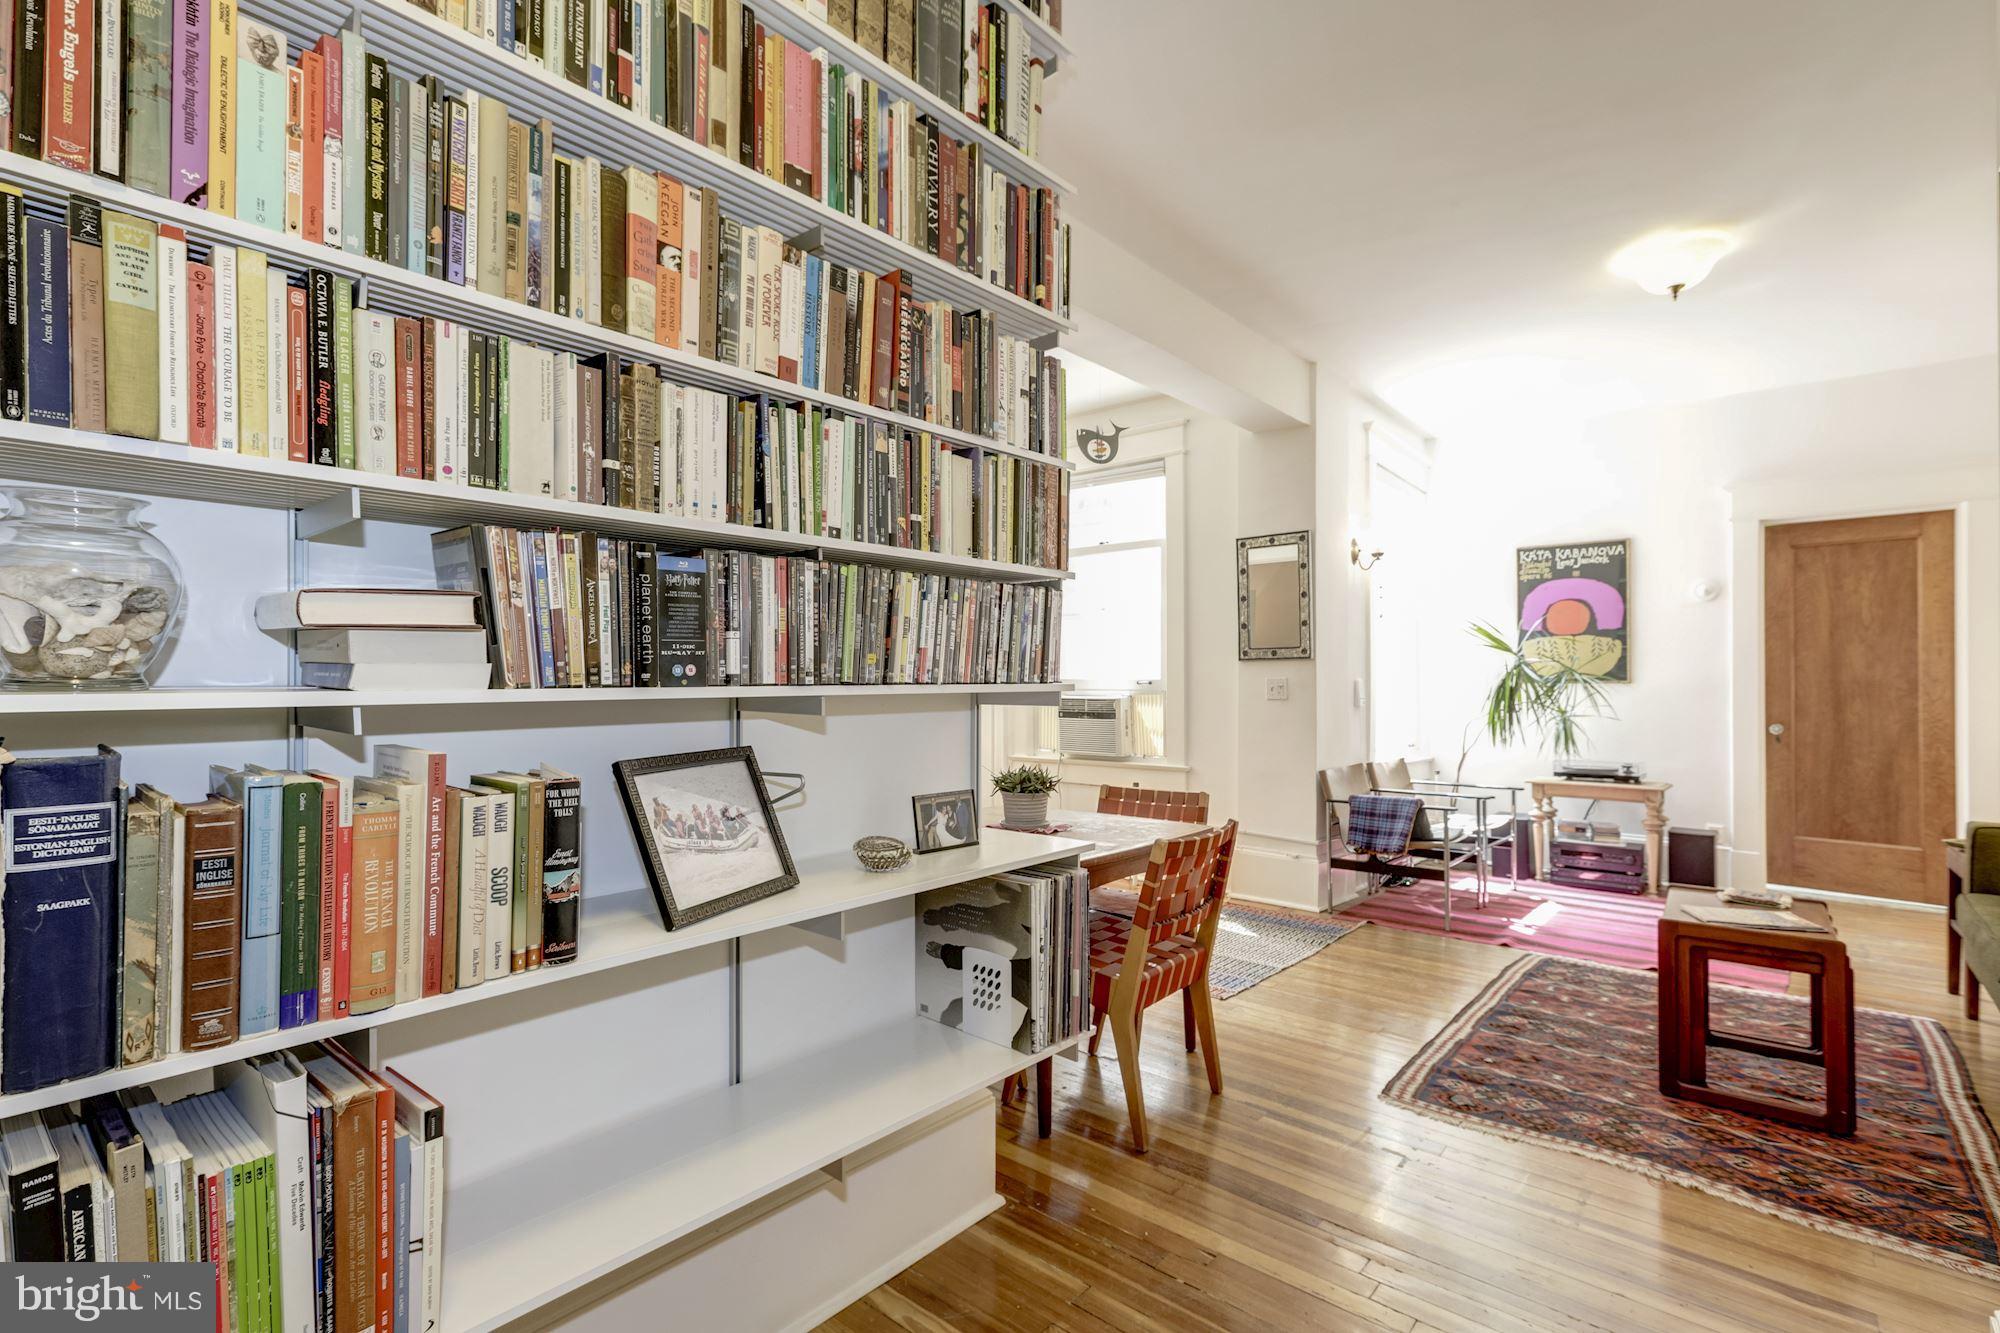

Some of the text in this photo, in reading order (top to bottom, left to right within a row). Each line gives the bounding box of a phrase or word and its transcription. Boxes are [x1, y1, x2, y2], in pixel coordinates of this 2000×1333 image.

[25, 11, 40, 51] Revolution
[574, 0, 585, 69] PUNISHMENT
[182, 0, 200, 146] khtin The Dialogic Imagination
[1020, 53, 1029, 121] SHATTERED
[62, 83, 75, 125] READER
[219, 55, 229, 154] DIALECTIC OF ENLIGHTENMENT
[367, 98, 385, 201] Ghost Stories and Mysteries
[468, 153, 477, 201] SIMULACRA
[927, 137, 939, 234] CHIVALRY
[371, 211, 384, 230] Dover
[659, 182, 670, 238] KEEGAN
[671, 200, 679, 227] JOHN
[114, 243, 150, 258] SAPPHIRA
[451, 212, 464, 265] FRANTZ FANON
[467, 210, 476, 265] SIMULATION
[6, 195, 18, 325] MADAME DE SÉVIGNÉ SELECTED LETTERS
[115, 251, 150, 265] AND THE
[119, 261, 146, 272] SLAVE
[40, 228, 53, 344] Actes du Tribunal révolutionnaire
[115, 281, 149, 294] CATHER
[122, 270, 144, 280] GIRL
[669, 277, 677, 292] THE
[89, 279, 99, 305] Typee
[659, 273, 668, 329] WORLD WAR
[761, 273, 772, 327] UP FOREVER
[315, 273, 330, 369] OCTAVIA E. BUTLER
[338, 282, 351, 375] UNDER THE GLACIER
[804, 292, 813, 337] HISTORY
[223, 256, 233, 423] PAUL TILLICH THE COURAGE TO BE
[898, 297, 909, 387] KIERKEGAARD
[377, 374, 387, 422] GAUDY NIGHT
[406, 366, 414, 408] DANIEL DEFOE
[423, 343, 434, 425] THE VOICES OF TIME
[316, 379, 331, 427] fledgling
[1554, 544, 1625, 561] KABANOVA
[586, 577, 596, 607] ANGELS
[664, 573, 701, 591] Harry Potter
[587, 613, 598, 645] AMERICA
[639, 573, 655, 665] planet earth
[299, 792, 307, 811] Collins
[545, 787, 580, 799] FOR WHOM
[547, 797, 579, 808] THE BELL
[27, 821, 101, 835] SÕNARAAMAT
[28, 813, 101, 827] EESTI-INGLISE
[361, 822, 398, 833] CARLYLE
[363, 815, 398, 826] THOMAS
[471, 805, 487, 837] WAUGH
[493, 801, 508, 833] WAUGH
[553, 807, 574, 818] TOLLS
[14, 835, 111, 853] ESTONIAN-ENGLISH
[32, 844, 97, 858] DICTIONARY
[259, 826, 274, 866] Journal
[551, 848, 574, 859] Ernest
[195, 868, 234, 882] INGLISE
[201, 858, 228, 870] EESTI
[259, 869, 273, 881] of
[297, 825, 307, 901] FROM TRIBES TO NATION
[428, 796, 442, 937] Art and the French Commune
[544, 856, 580, 867] Hemingway
[258, 883, 273, 903] My
[323, 804, 334, 962] FRENCH REVOLUTION INTELLECTUAL HISTORY
[363, 859, 380, 935] REVOLUTION
[381, 859, 394, 928] THE FRENCH
[490, 866, 509, 907] SCOOP
[36, 897, 92, 912] SAAGPAKK
[258, 906, 272, 928] Life
[341, 897, 349, 923] Revolution
[545, 941, 577, 954] Scribners
[321, 967, 331, 995] CENSER
[369, 986, 388, 997] G13
[21, 1173, 55, 1190] RAMOS
[290, 1183, 299, 1226] Five Decades
[298, 1180, 307, 1232] Melvin Edwards
[71, 1209, 87, 1262] AFRICAN
[356, 1147, 366, 1330] THE CRITICAL TEMPER OF ALAIN LOCKE
